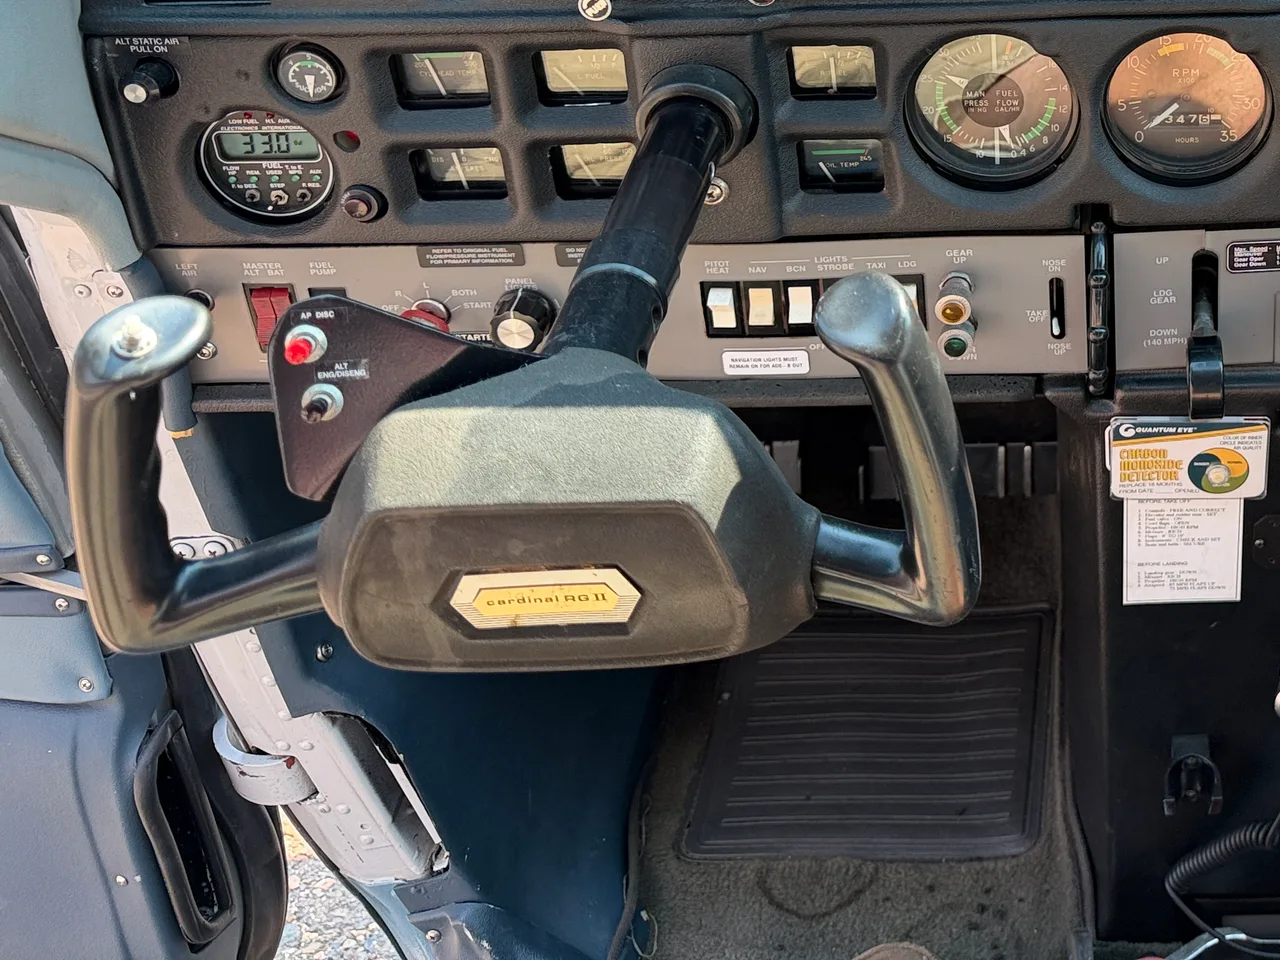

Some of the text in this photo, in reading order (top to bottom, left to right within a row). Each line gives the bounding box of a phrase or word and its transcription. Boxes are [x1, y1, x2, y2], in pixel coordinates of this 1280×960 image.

[1220, 131, 1238, 143] 35
[817, 263, 854, 271] STROBE
[866, 262, 886, 270] TAXI
[318, 370, 366, 378] ENG/DISENG
[1120, 449, 1168, 459] CARBON
[1120, 471, 1179, 482] DETECTOR
[487, 593, 606, 606] cardinal RG II
